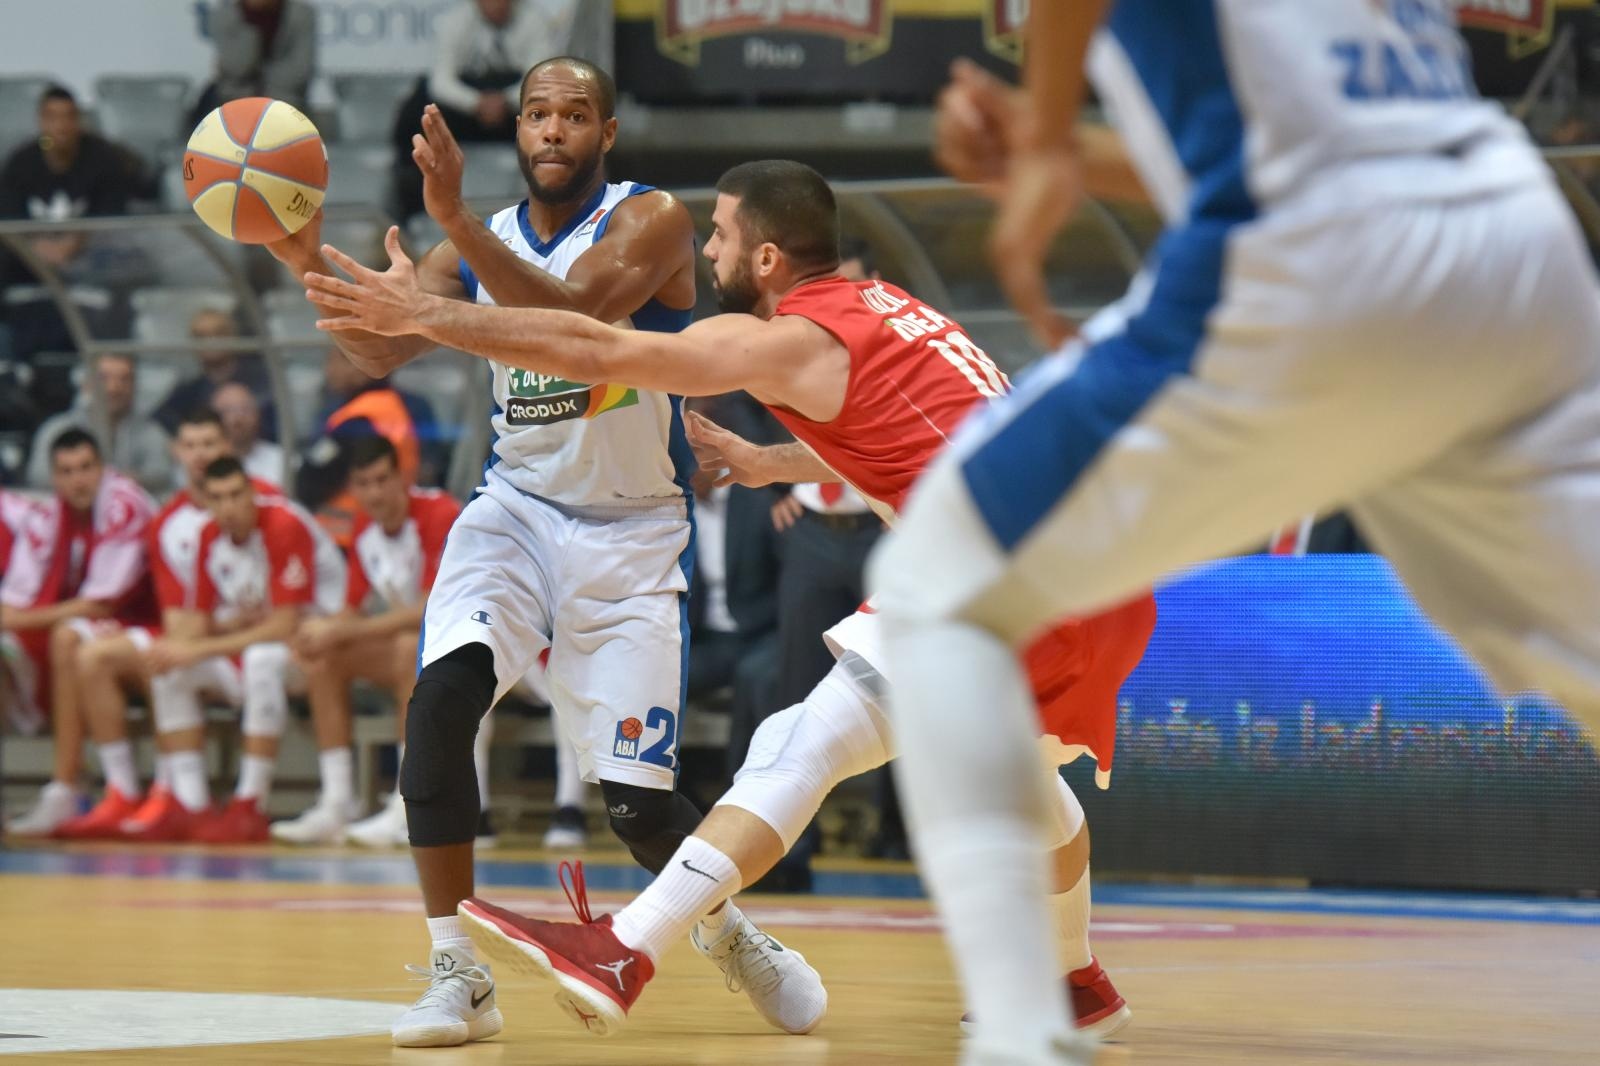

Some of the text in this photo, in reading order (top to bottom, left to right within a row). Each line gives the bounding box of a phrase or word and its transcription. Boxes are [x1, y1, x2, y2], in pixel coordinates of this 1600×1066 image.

[510, 399, 577, 419] CRODUX
[615, 706, 676, 769] ABA 2
